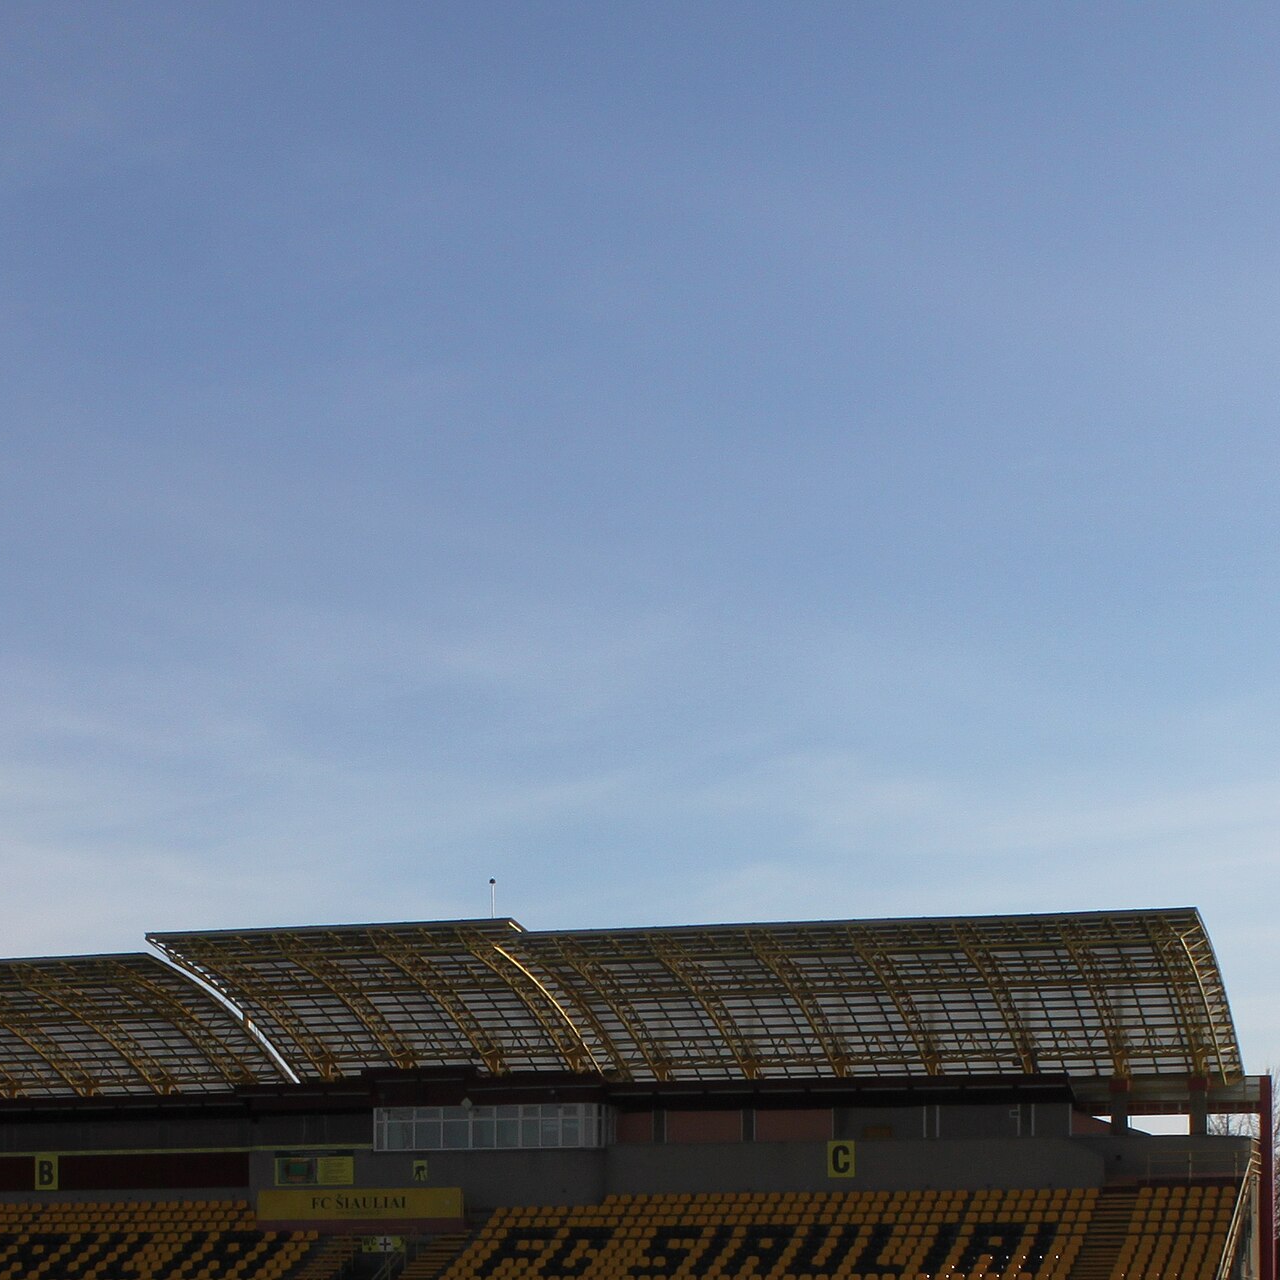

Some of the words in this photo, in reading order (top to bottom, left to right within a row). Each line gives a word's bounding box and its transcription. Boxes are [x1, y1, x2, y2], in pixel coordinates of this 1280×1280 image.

[832, 1145, 850, 1173] C
[39, 1160, 53, 1185] B
[312, 1196, 331, 1210] FC
[335, 1194, 407, 1209] ŠIAULIAI
